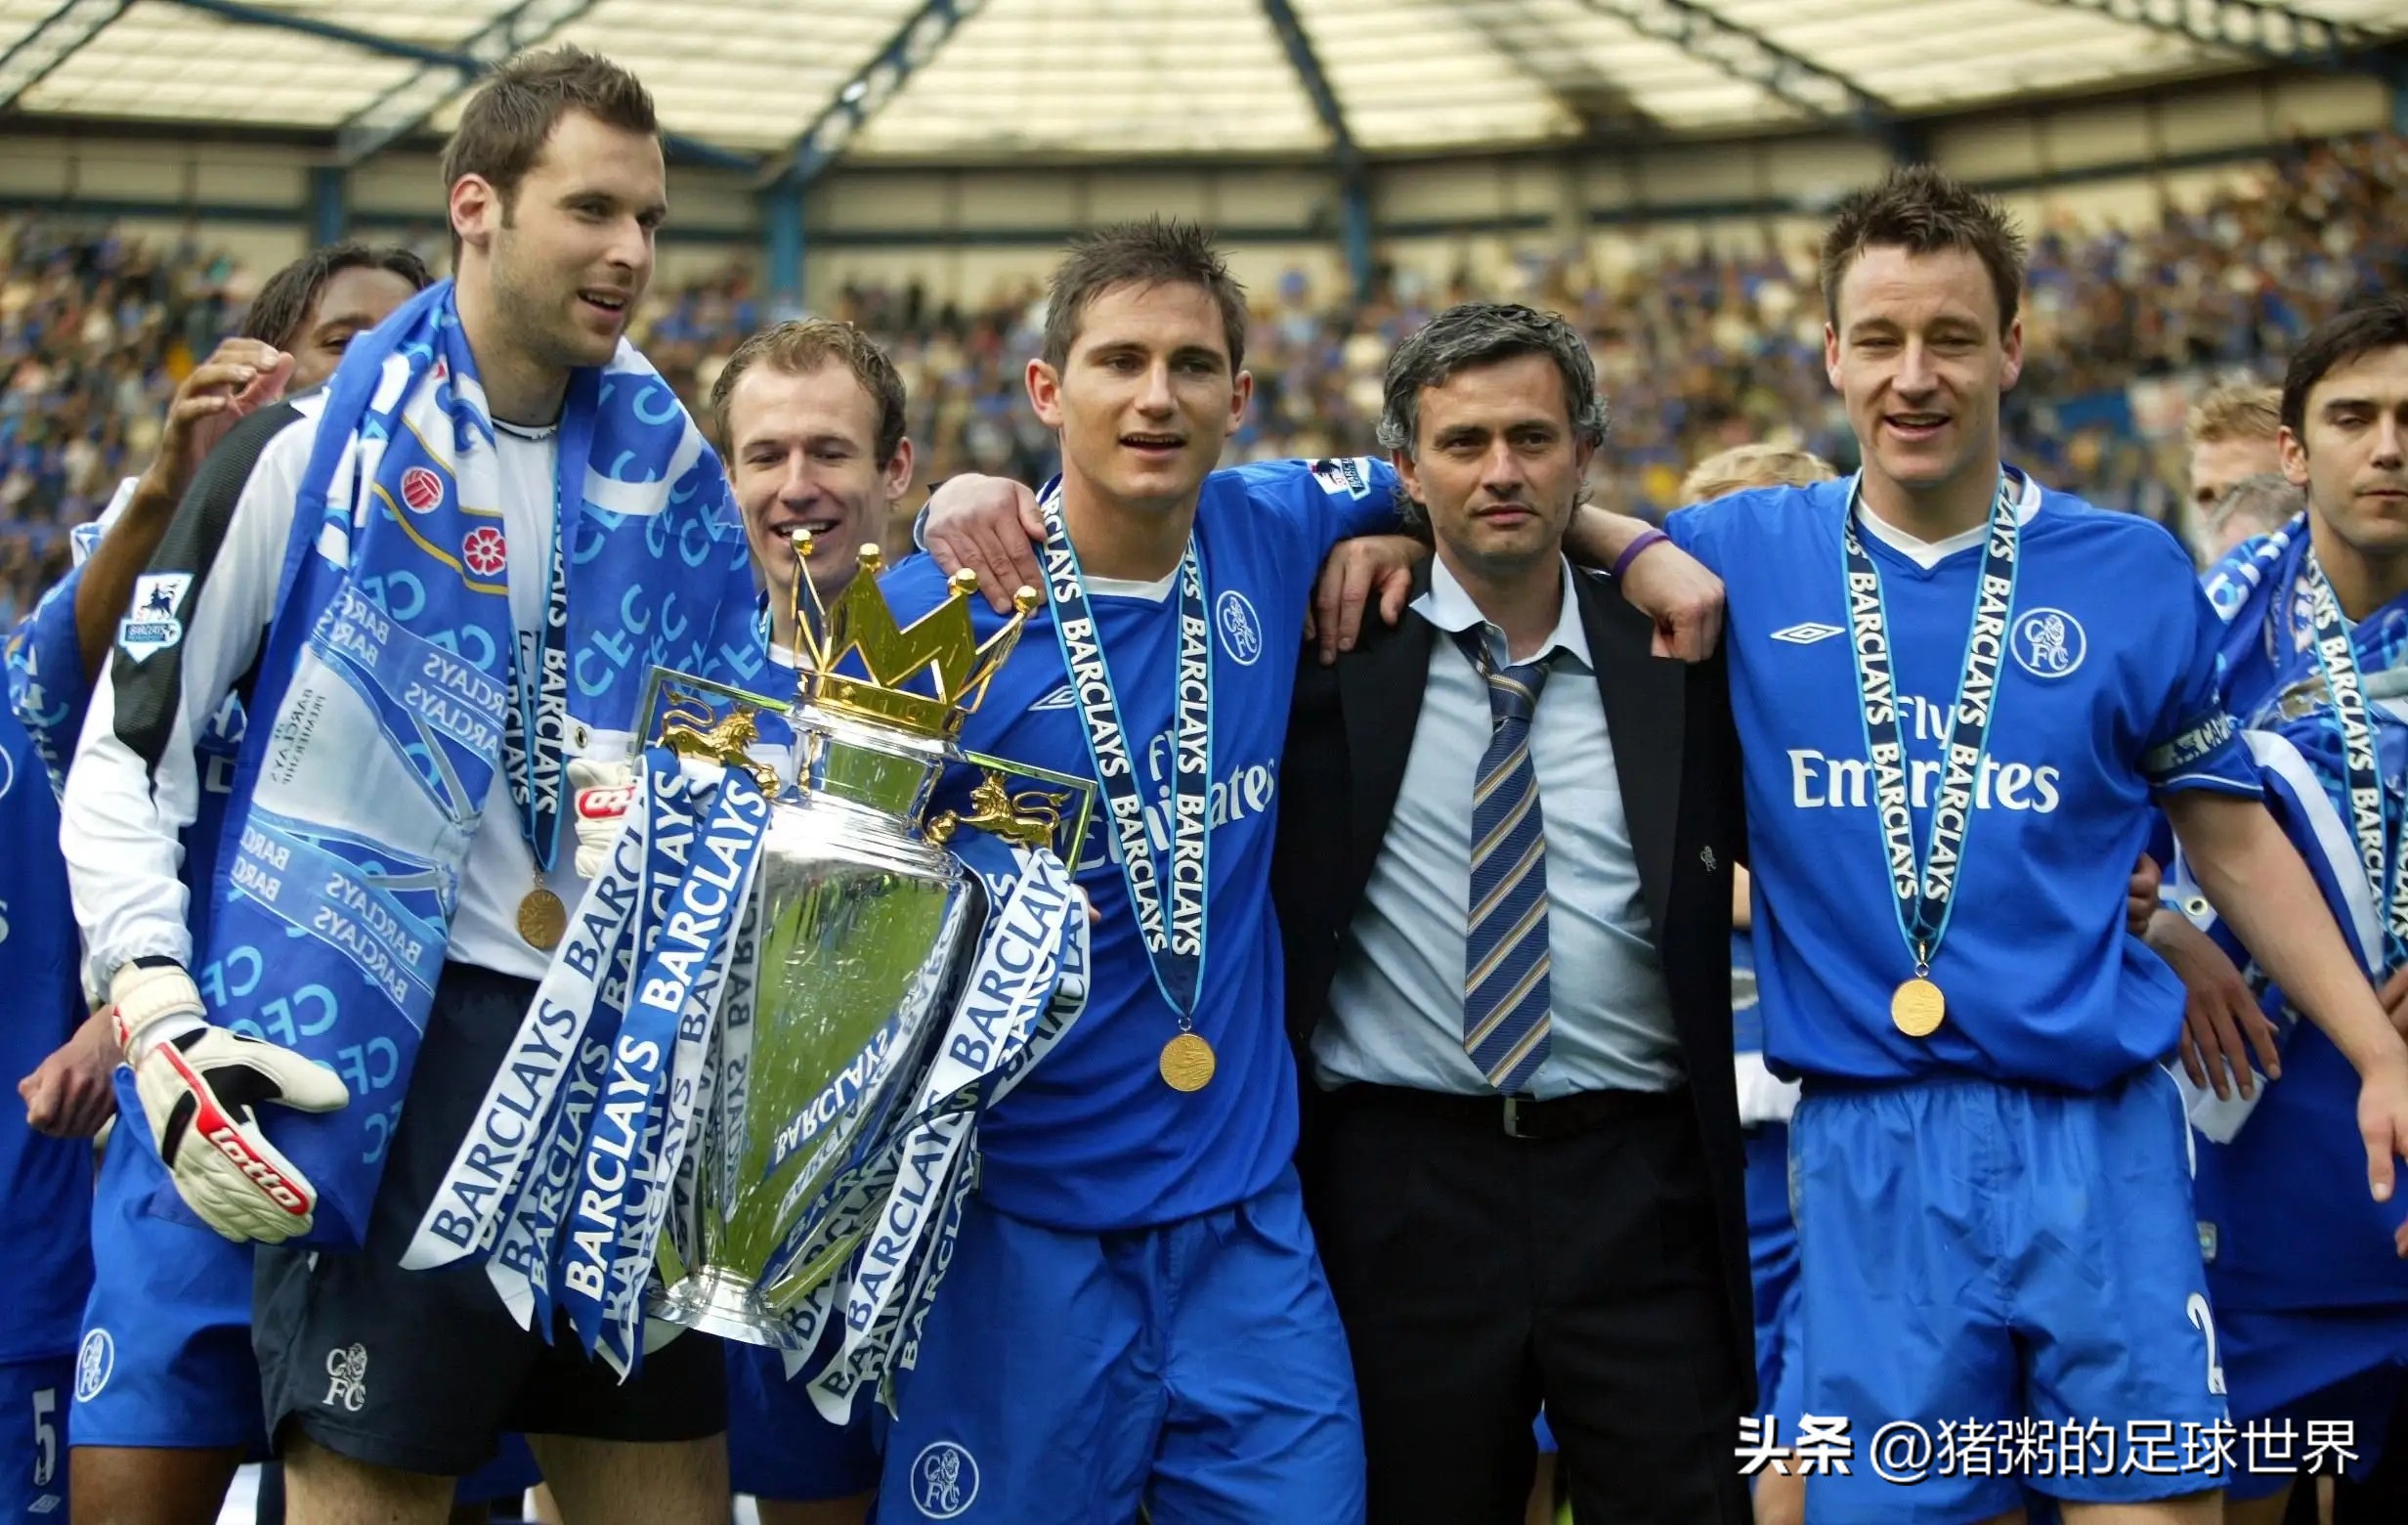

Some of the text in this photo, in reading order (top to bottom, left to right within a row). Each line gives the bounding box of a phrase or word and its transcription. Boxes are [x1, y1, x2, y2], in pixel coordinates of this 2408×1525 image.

[1062, 618, 1131, 779] BARCLAYS
[1177, 614, 1208, 774] BARCLAYS
[1848, 572, 1896, 725] BARCLAYS
[1957, 574, 2011, 727] BARCLAYS
[2320, 635, 2376, 771] BARCLAYS
[535, 647, 567, 815] BARCLAYS
[640, 779, 767, 1013] BARCLAYS
[1110, 794, 1168, 954] BARCLAYS
[1172, 794, 1206, 957] BARCLAYS
[1871, 742, 1918, 899] BARCLAYS
[1924, 743, 1979, 903] BARCLAYS
[430, 998, 577, 1249] BARCLAYS
[531, 1036, 611, 1298] BARCLAYS
[565, 1034, 660, 1302] BARCLAYS
[32, 1387, 57, 1486] 5
